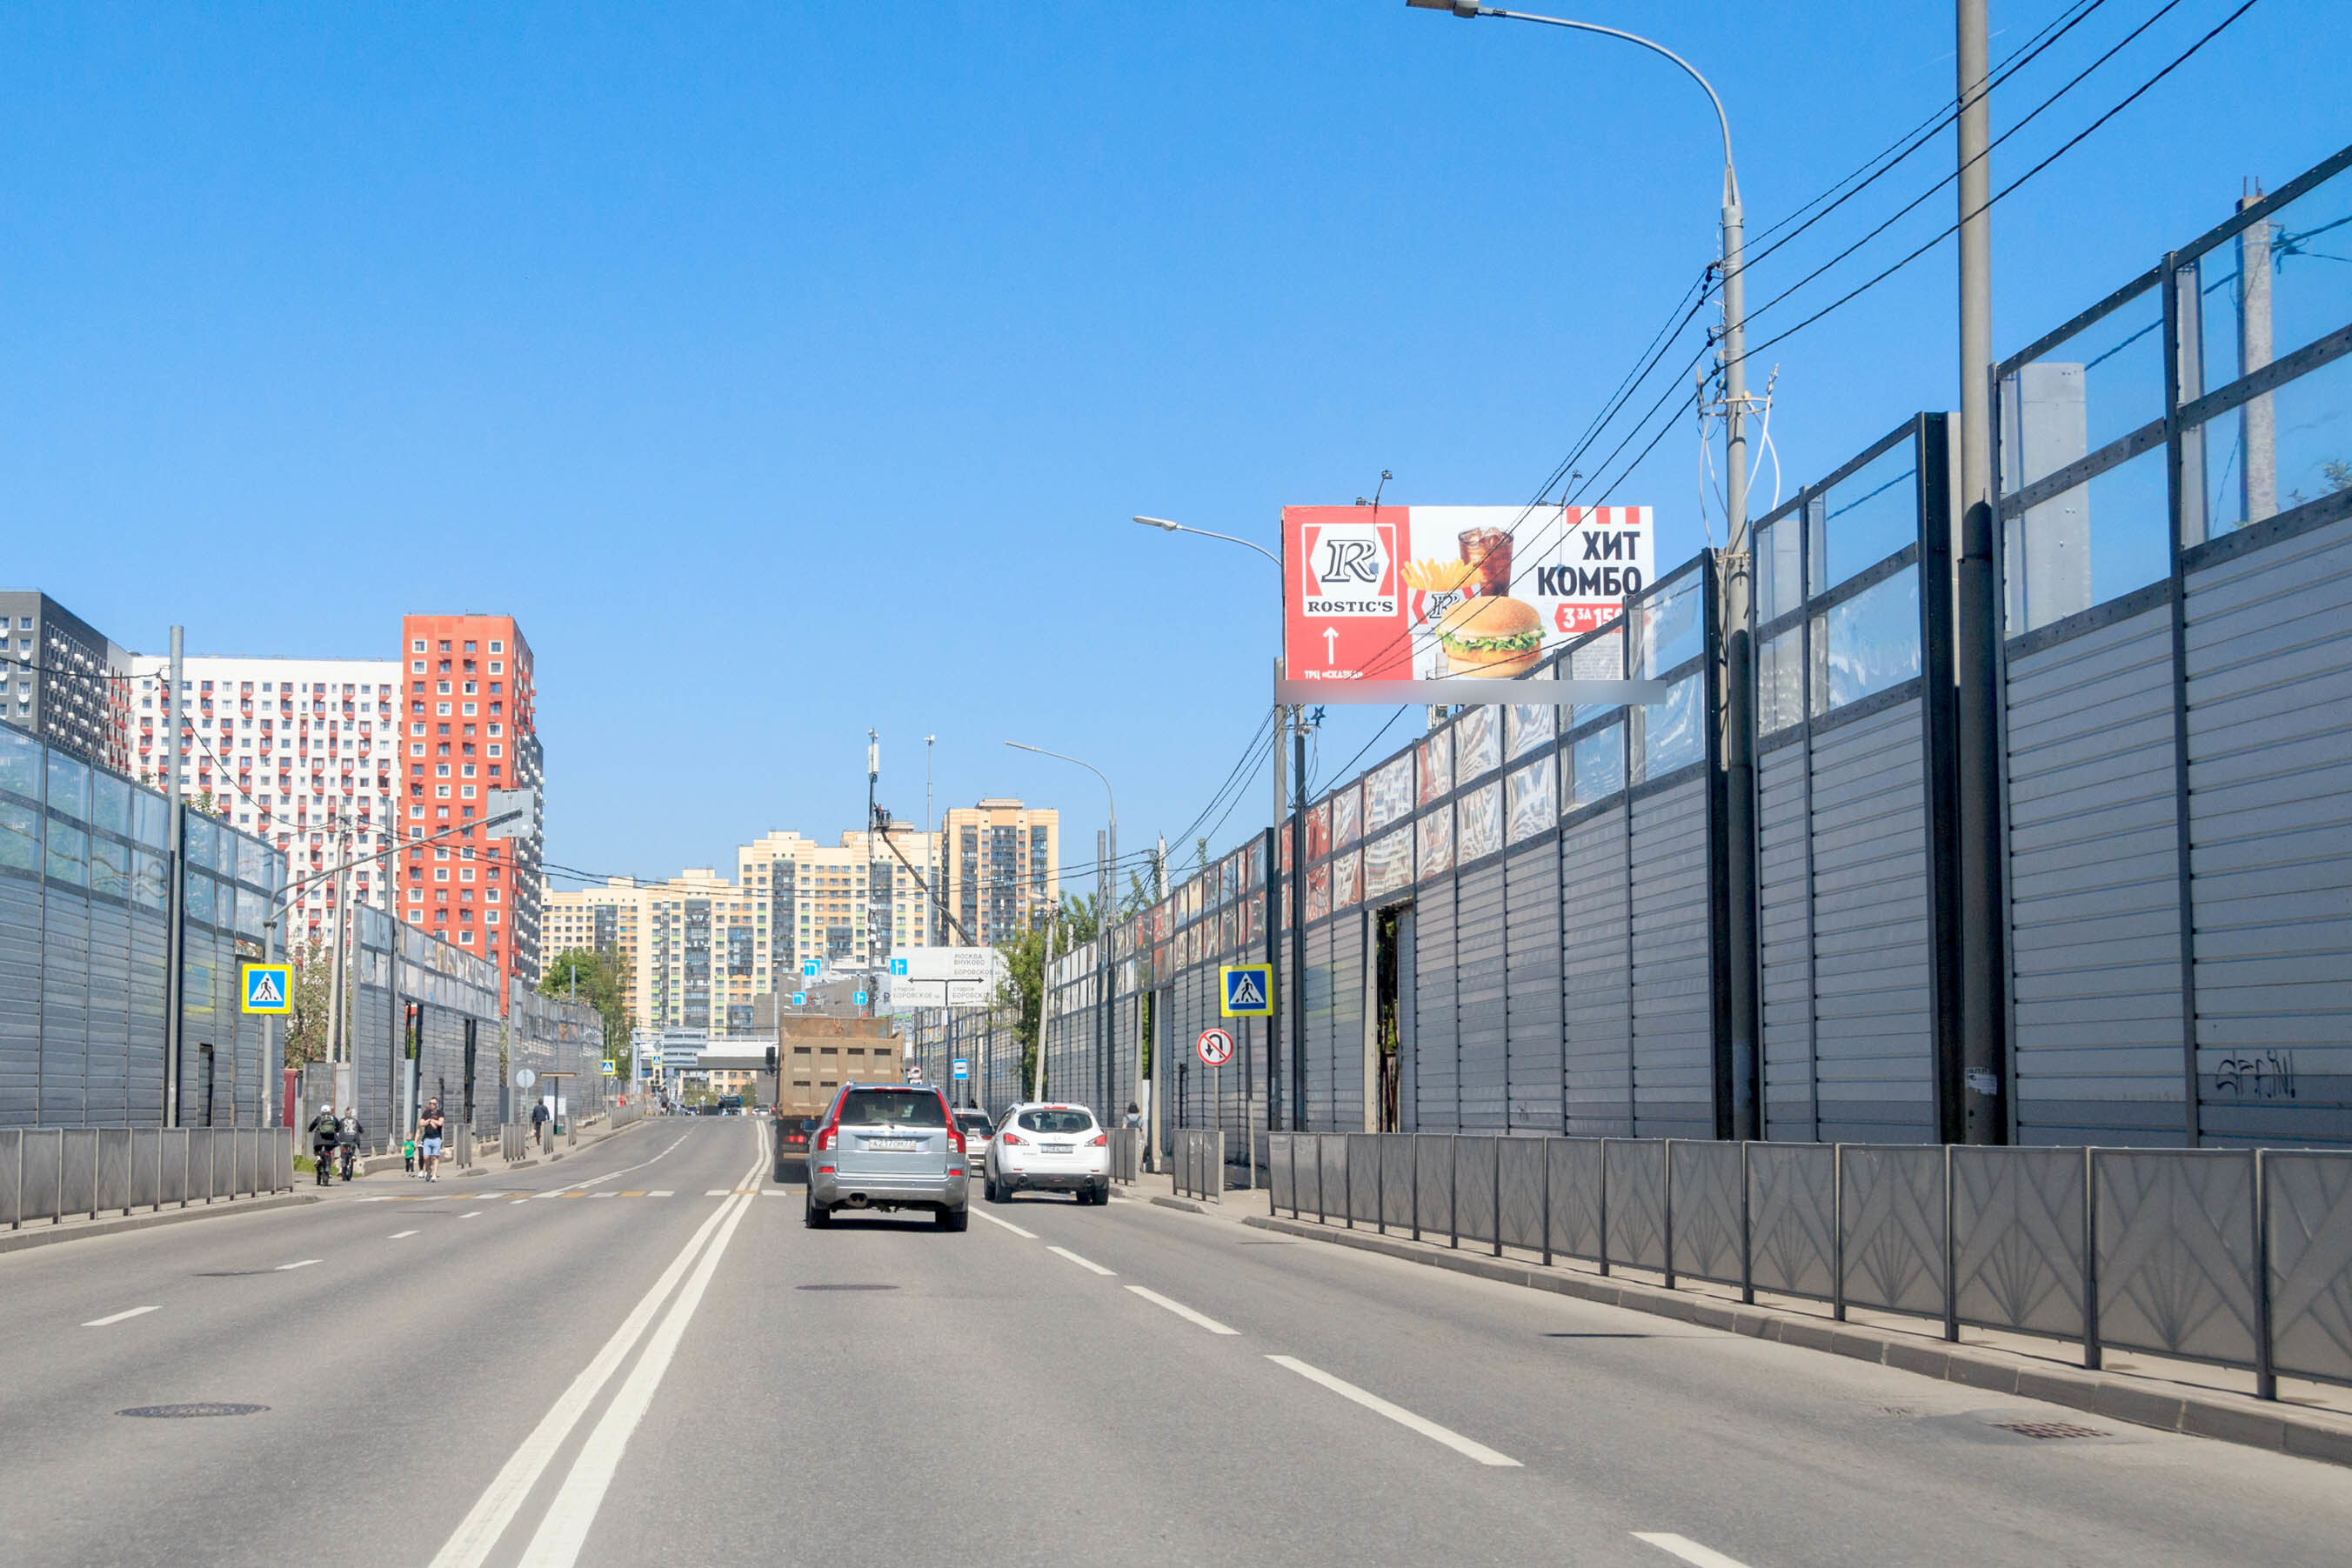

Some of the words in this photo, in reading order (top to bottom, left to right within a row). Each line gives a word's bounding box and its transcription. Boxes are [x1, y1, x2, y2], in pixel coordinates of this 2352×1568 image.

[1582, 531, 1640, 560] ХИТ
[1538, 567, 1642, 596] КОМБО
[1307, 601, 1393, 612] ROSTIC'S
